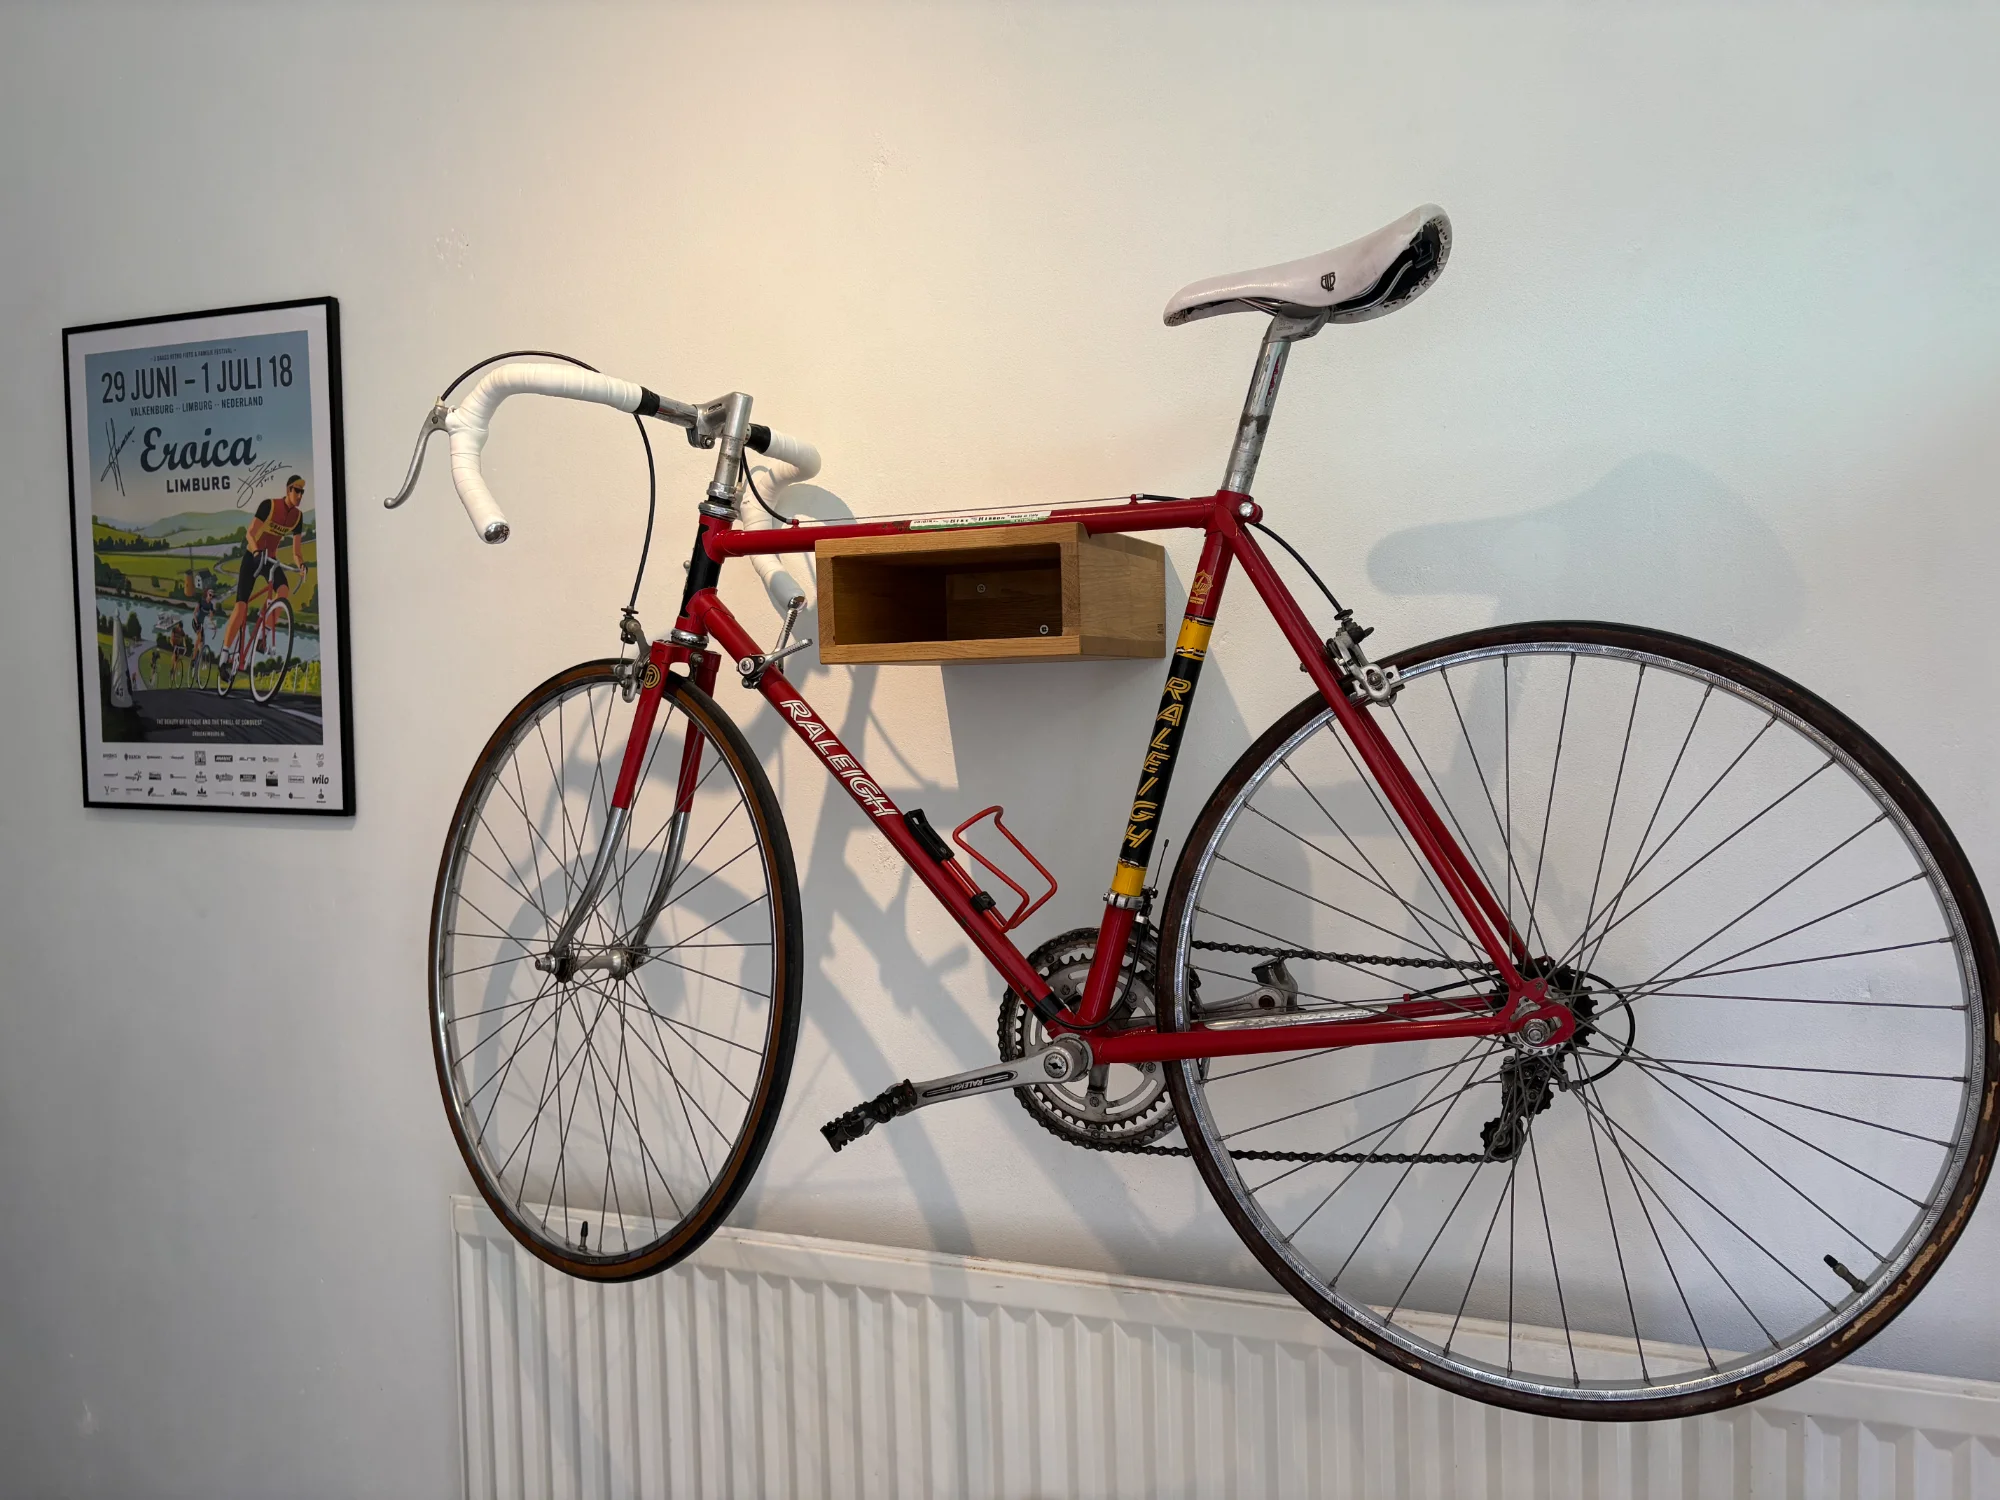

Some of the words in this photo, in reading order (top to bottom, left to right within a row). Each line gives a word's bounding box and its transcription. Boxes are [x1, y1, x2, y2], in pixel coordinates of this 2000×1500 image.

[101, 371, 125, 404] 29
[131, 365, 178, 401] JUNI
[201, 362, 209, 393] 1
[217, 357, 262, 393] JULI
[269, 354, 293, 388] 18
[130, 404, 174, 417] VALKENBURG
[182, 400, 213, 412] LIMBURG
[221, 396, 263, 409] NEDERLAND
[140, 427, 257, 473] Eroica
[166, 475, 231, 493] LIMBURG
[780, 699, 898, 817] RALEIGH
[1124, 676, 1191, 849] RALEIGH
[312, 775, 329, 785] wilo
[951, 1079, 983, 1092] RALEIGH
